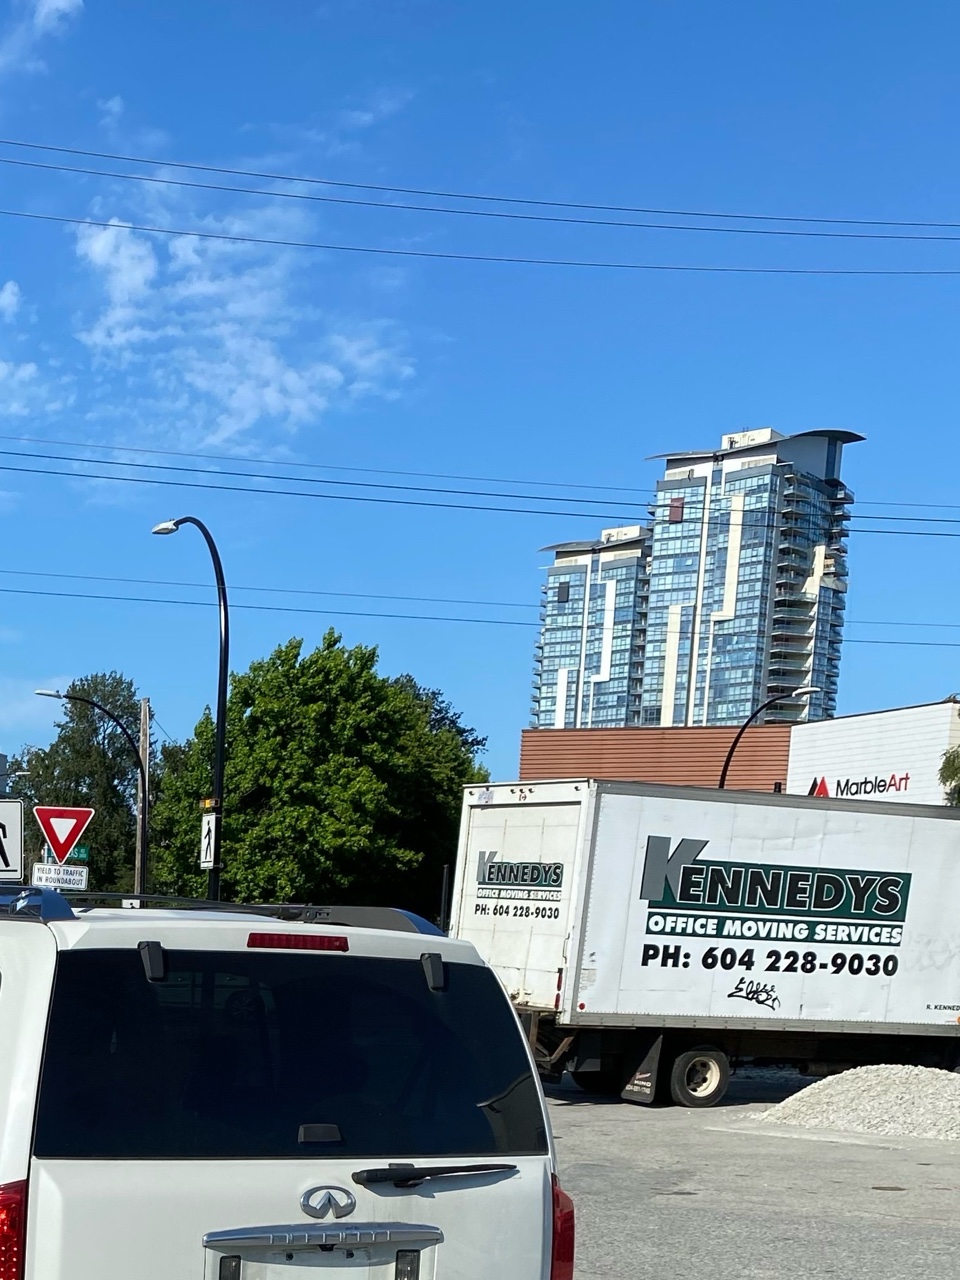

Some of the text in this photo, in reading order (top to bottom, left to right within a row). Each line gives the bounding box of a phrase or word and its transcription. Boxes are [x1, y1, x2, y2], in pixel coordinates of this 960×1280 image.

[836, 773, 910, 797] MarbleArt
[37, 867, 51, 875] YIELD
[63, 869, 84, 877] TRAFFIC
[476, 851, 562, 885] KENNEDYS
[640, 835, 904, 915] KENNEDYS
[45, 877, 83, 886] ROUNDABOUT
[478, 889, 562, 901] OFFICE MOVING SERVICES
[474, 904, 560, 919] PH: 604 228-9030
[648, 915, 903, 944] OFFICE MOVING SERVICES
[641, 944, 899, 976] PH: 604 228-9030
